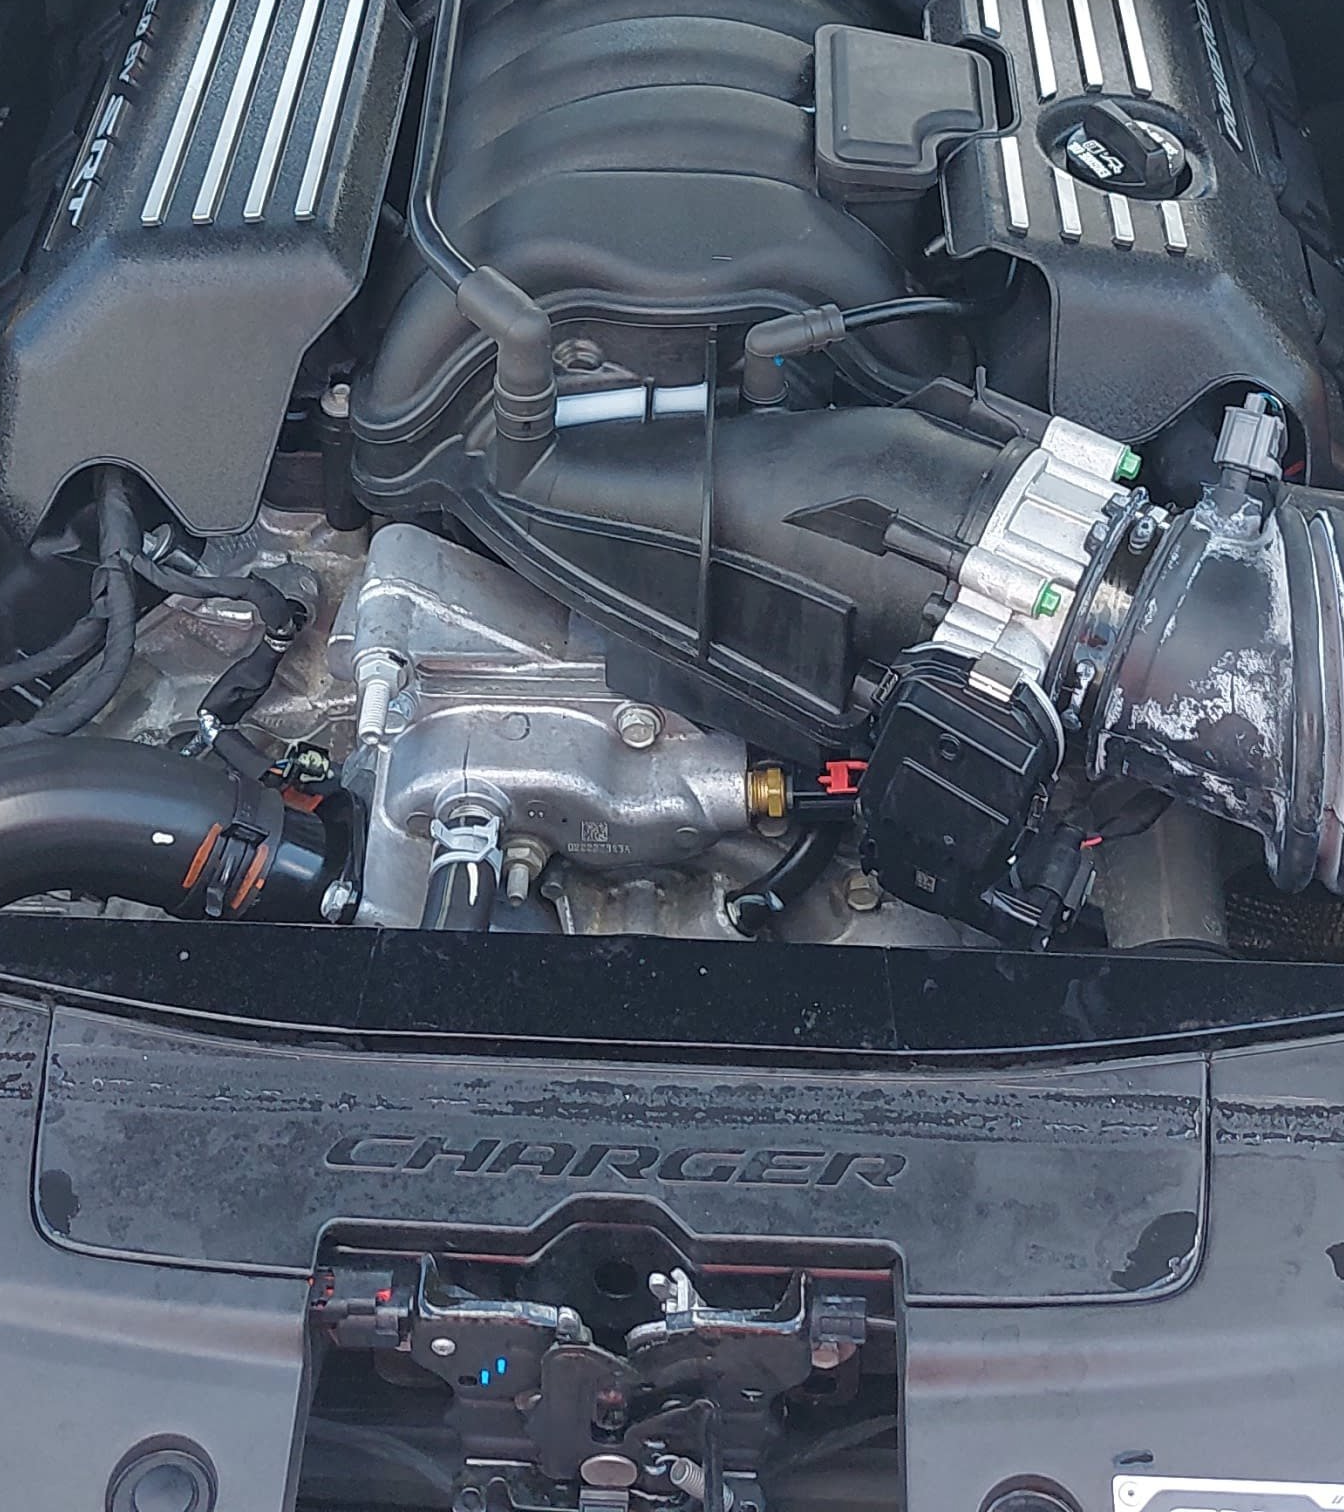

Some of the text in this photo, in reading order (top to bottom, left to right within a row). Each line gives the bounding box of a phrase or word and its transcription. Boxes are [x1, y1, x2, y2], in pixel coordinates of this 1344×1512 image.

[118, 39, 147, 86] BY
[66, 93, 126, 227] SRT
[325, 1133, 908, 1189] CHARGER
